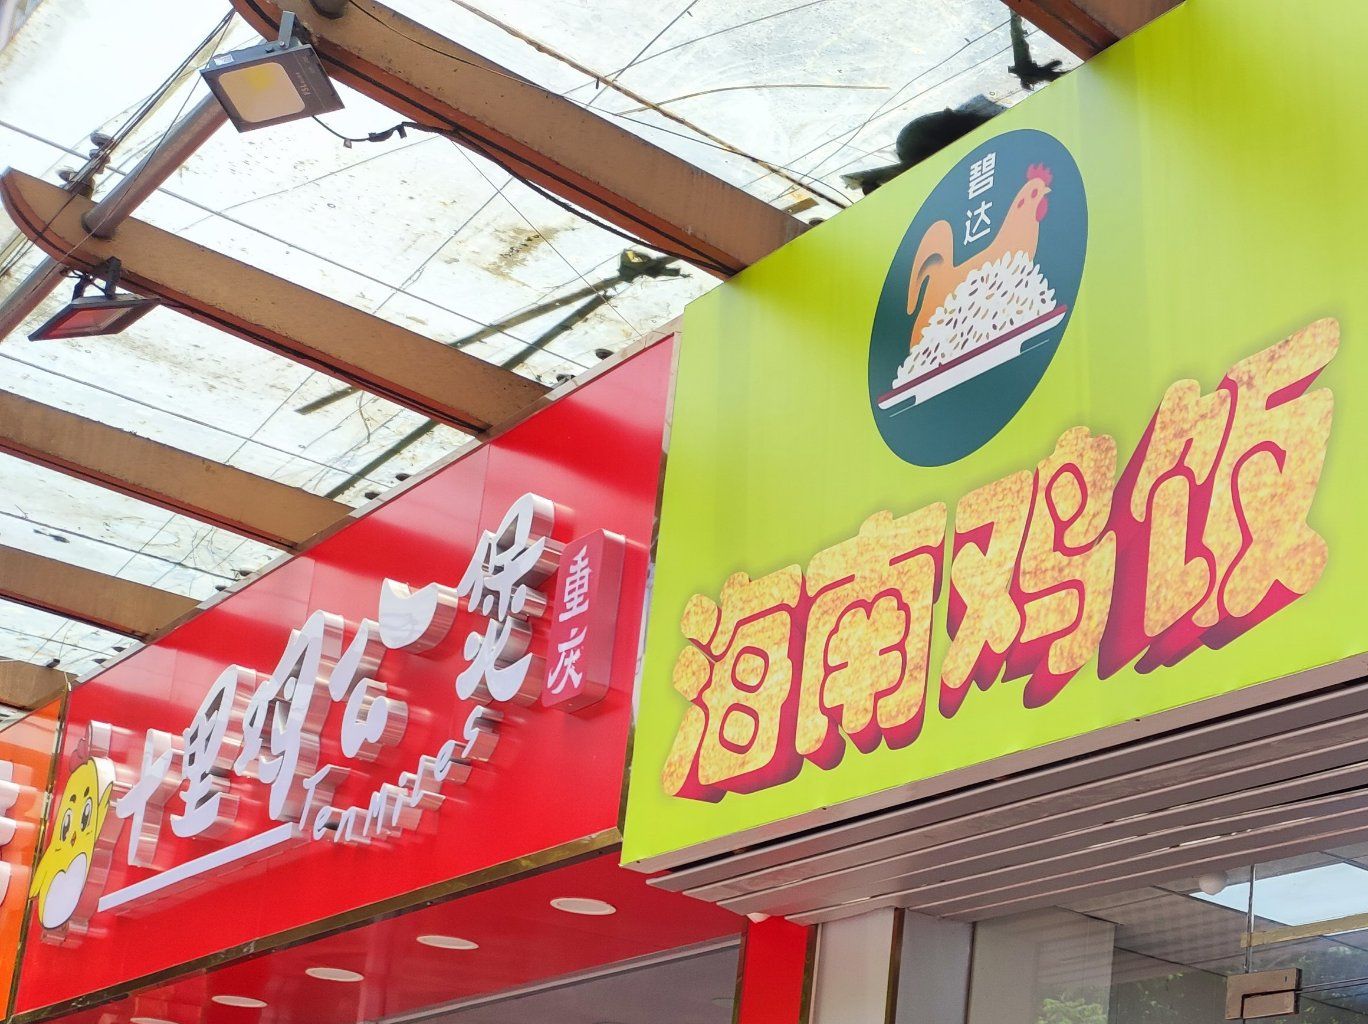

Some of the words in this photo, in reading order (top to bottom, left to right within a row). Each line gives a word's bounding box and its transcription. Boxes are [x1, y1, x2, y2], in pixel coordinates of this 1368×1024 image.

[962, 152, 998, 247] 碧达
[547, 543, 596, 702] 重庆
[660, 317, 1341, 803] 海南鸡饭
